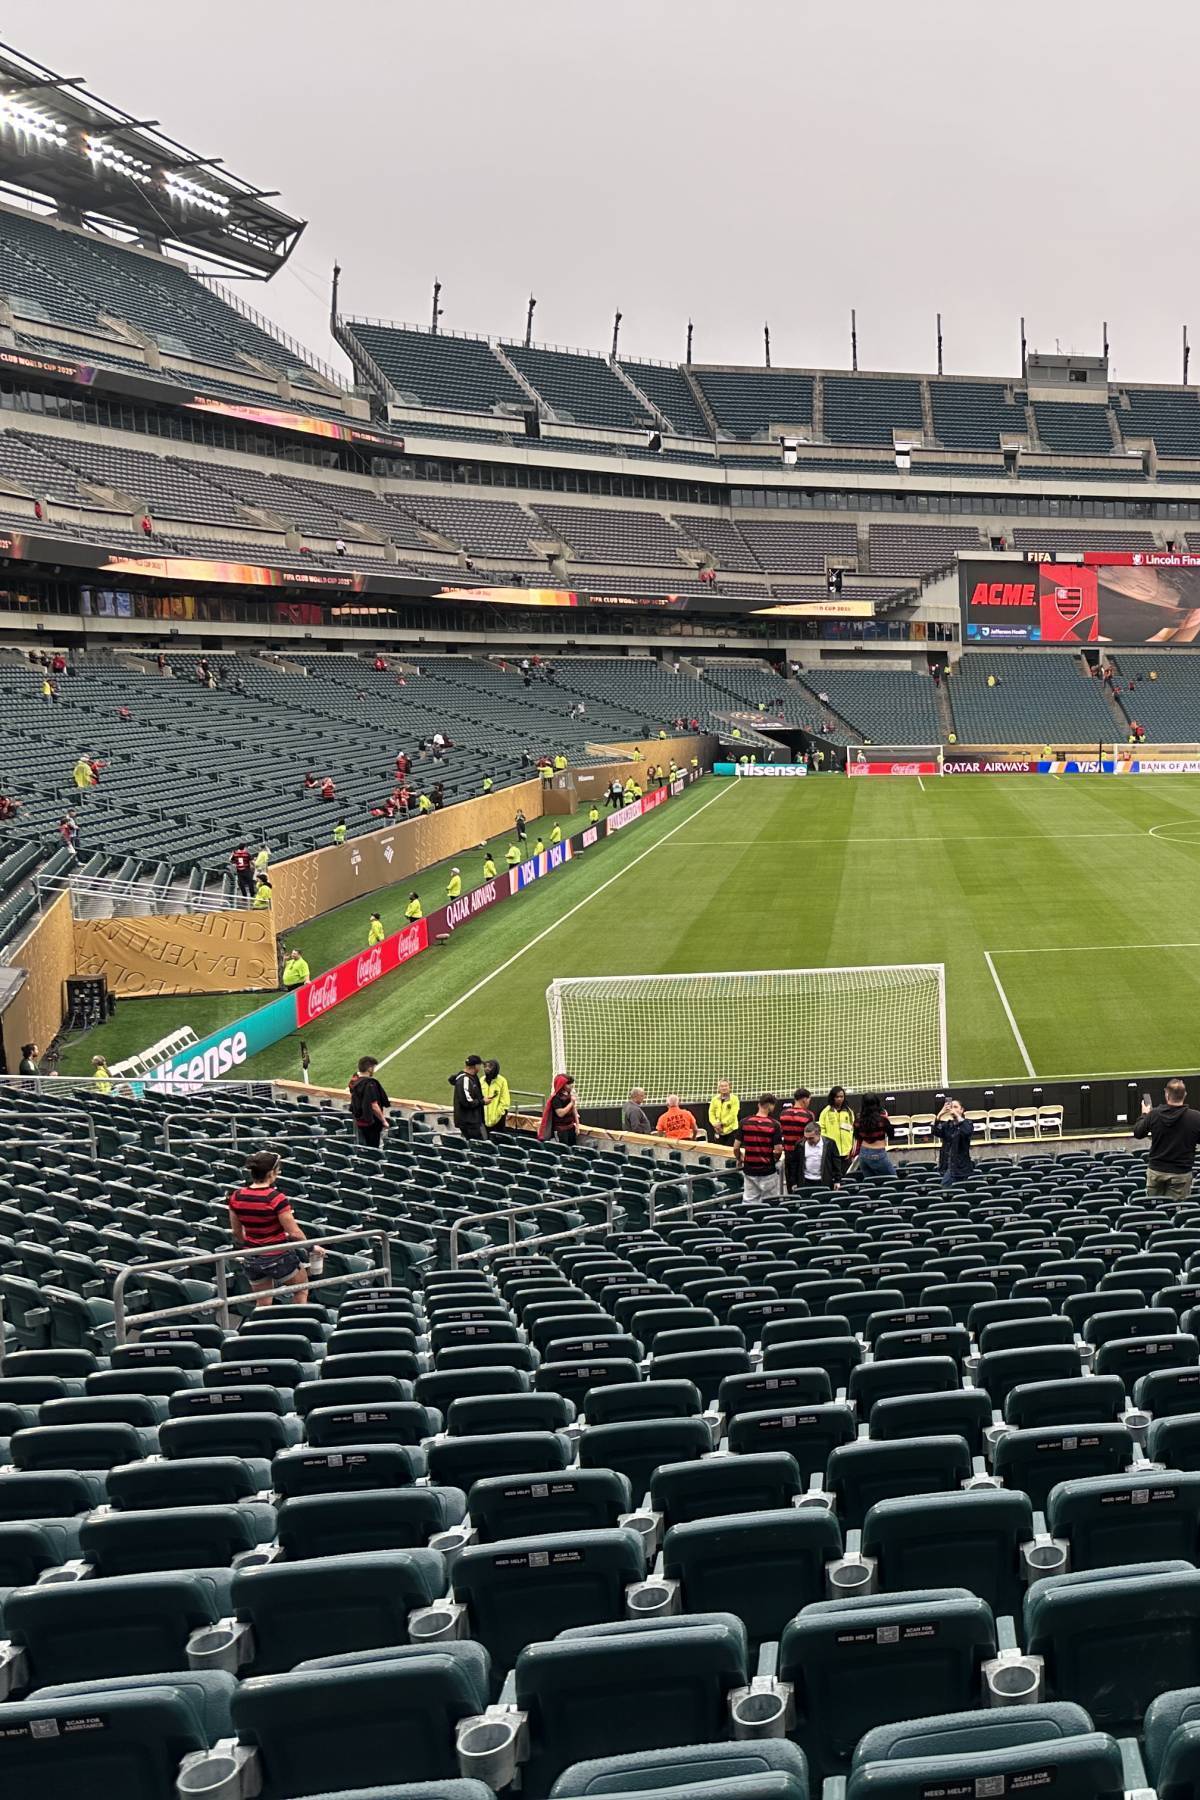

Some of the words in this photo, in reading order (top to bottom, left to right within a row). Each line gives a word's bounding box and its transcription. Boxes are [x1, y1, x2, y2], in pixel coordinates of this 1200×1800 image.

[1027, 552, 1052, 562] FIFA
[1146, 555, 1180, 564] Lincoln
[971, 583, 1034, 606] ACME
[735, 762, 807, 777] Hisense
[943, 762, 980, 773] QATAR
[983, 762, 1030, 772] AIRWAYS
[1075, 762, 1105, 773] VISA
[550, 844, 563, 869] VISA
[520, 859, 536, 886] VISA
[446, 896, 470, 930] QATAR
[470, 881, 497, 913] AIRWAYS
[398, 925, 420, 961] Coca-Cola
[357, 947, 382, 987] Coca-Cola
[308, 972, 338, 1018] Coca-Cola
[1014, 1775, 1033, 1783] SCAN
[924, 1789, 946, 1797] NEED
[947, 1787, 972, 1795] HELP?
